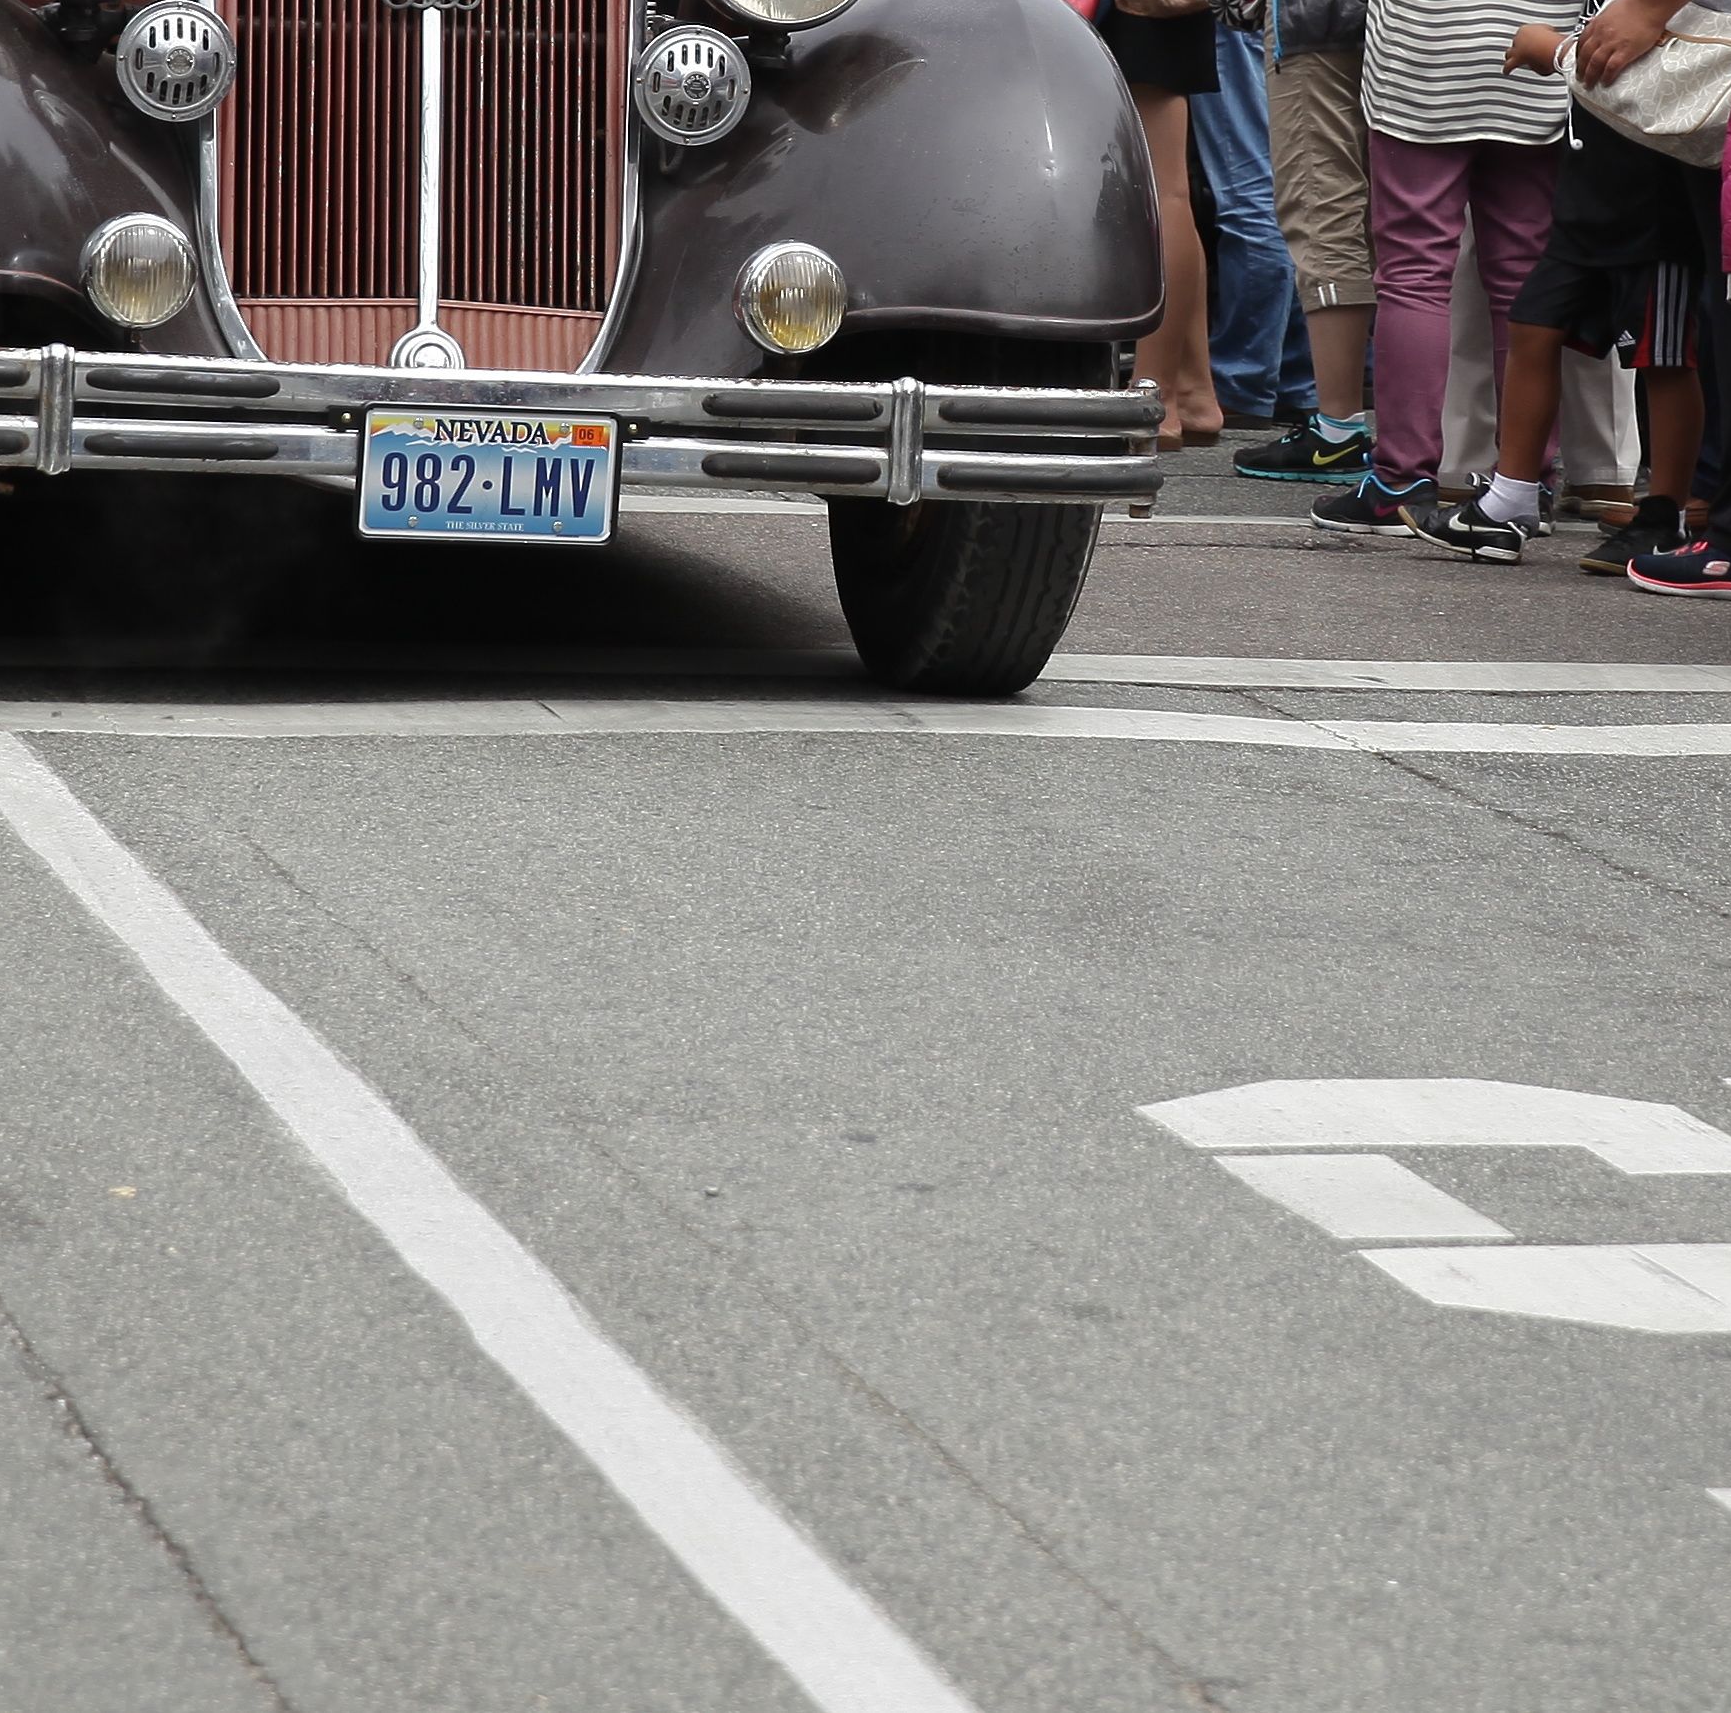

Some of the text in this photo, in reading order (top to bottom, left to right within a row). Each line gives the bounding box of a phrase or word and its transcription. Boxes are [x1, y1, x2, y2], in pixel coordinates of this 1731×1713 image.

[433, 419, 550, 446] NEVADA
[578, 428, 595, 440] 06
[445, 520, 525, 532] THE SILVER STATE
